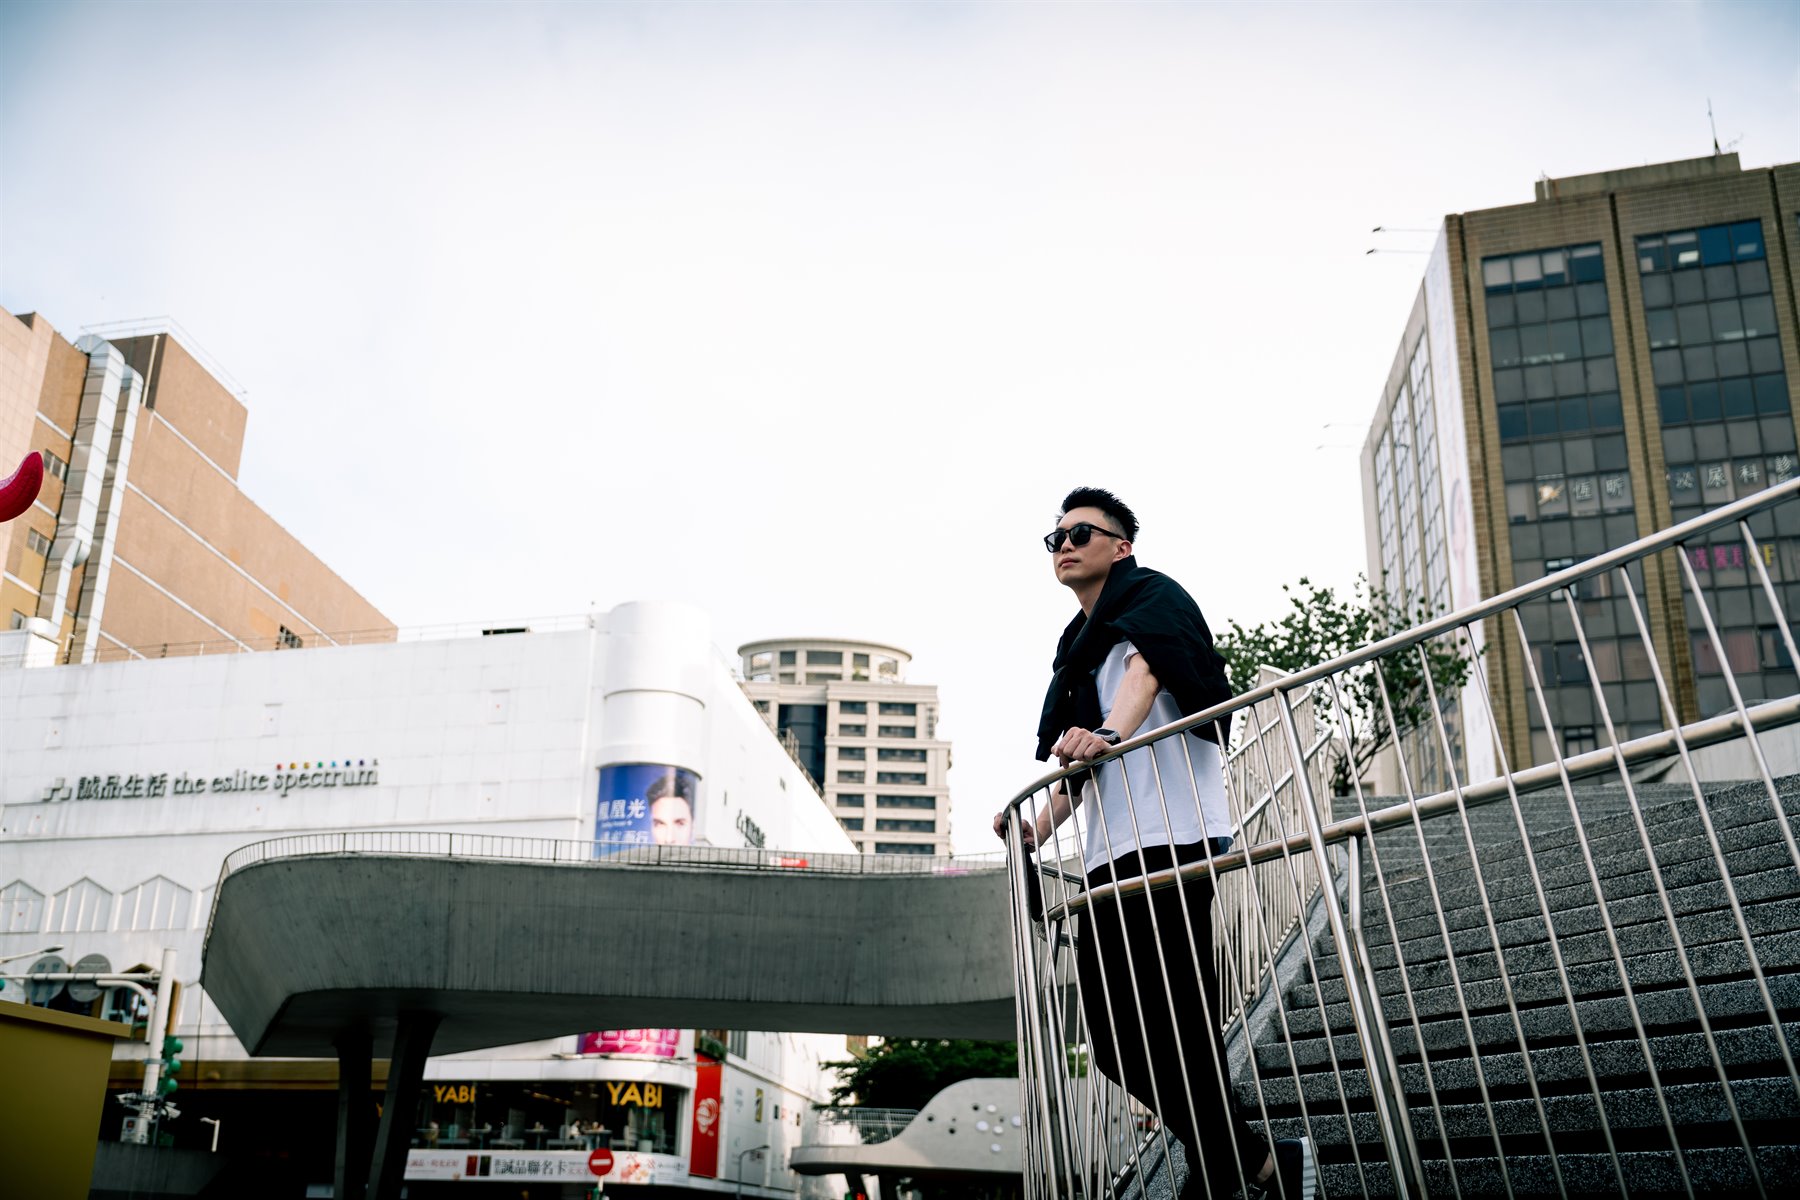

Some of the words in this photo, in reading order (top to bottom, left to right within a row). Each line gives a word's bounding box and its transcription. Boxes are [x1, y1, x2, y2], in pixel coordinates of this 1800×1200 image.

[77, 773, 167, 800] 誠品生活
[173, 772, 206, 795] the
[211, 769, 269, 793] eslite
[273, 768, 379, 798] spectrum
[434, 1085, 475, 1104] YABI
[607, 1081, 663, 1108] YABI
[500, 1158, 567, 1176] 誠品聯名卡
